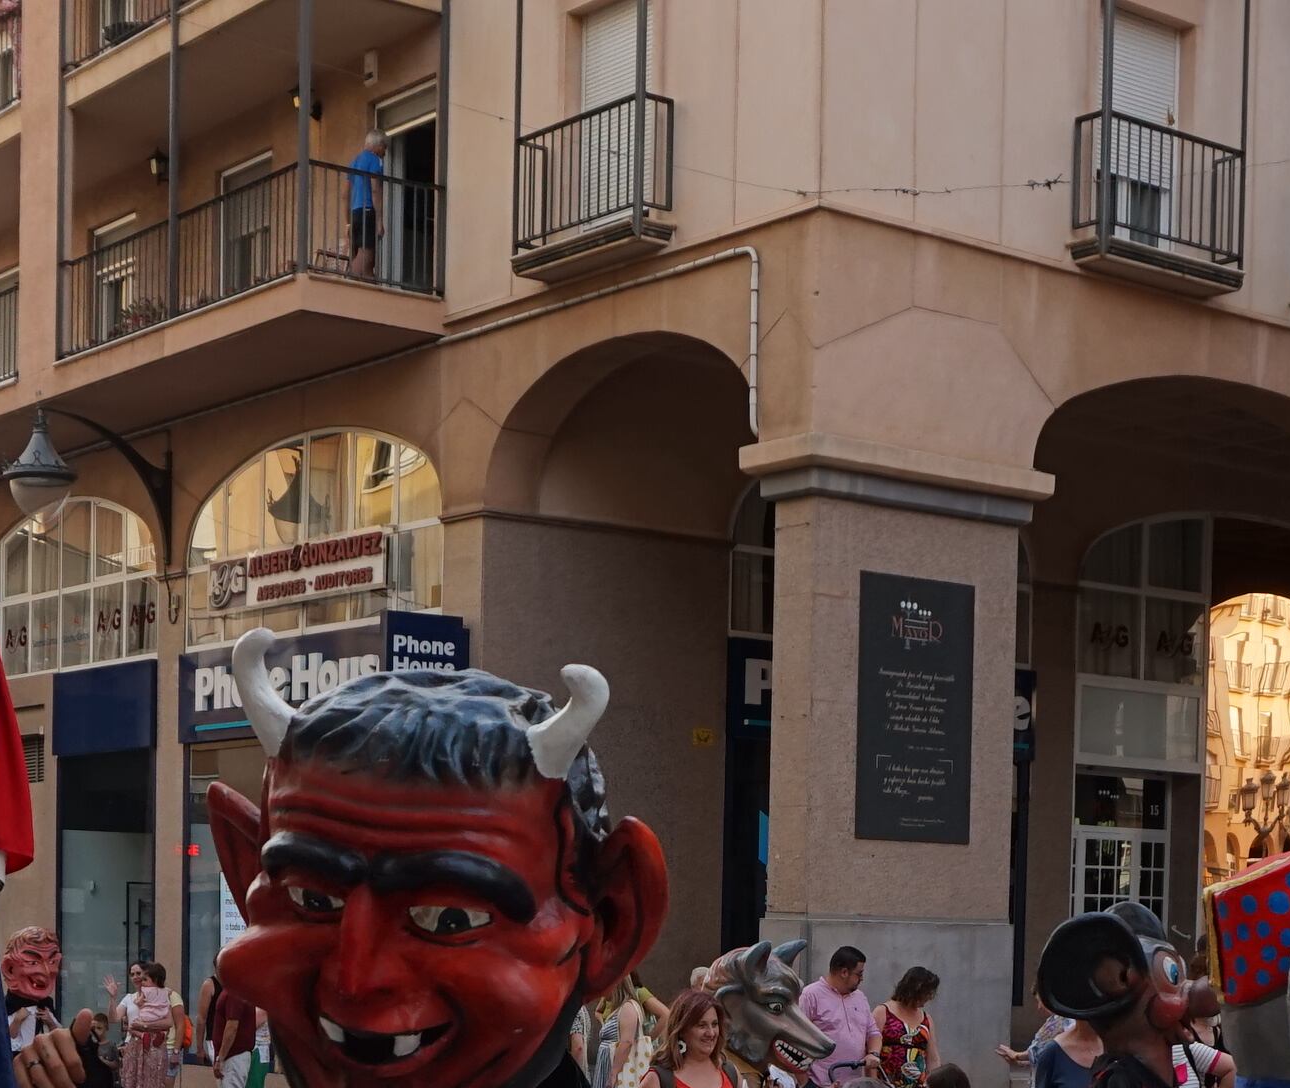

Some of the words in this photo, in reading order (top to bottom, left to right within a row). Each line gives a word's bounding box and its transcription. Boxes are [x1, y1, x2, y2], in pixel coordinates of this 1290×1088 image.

[248, 549, 293, 578] ALBERT
[301, 531, 384, 568] GONZALVEZ
[256, 578, 306, 602] ASESORES
[314, 566, 373, 591] AUDITORES
[393, 634, 455, 657] Phone
